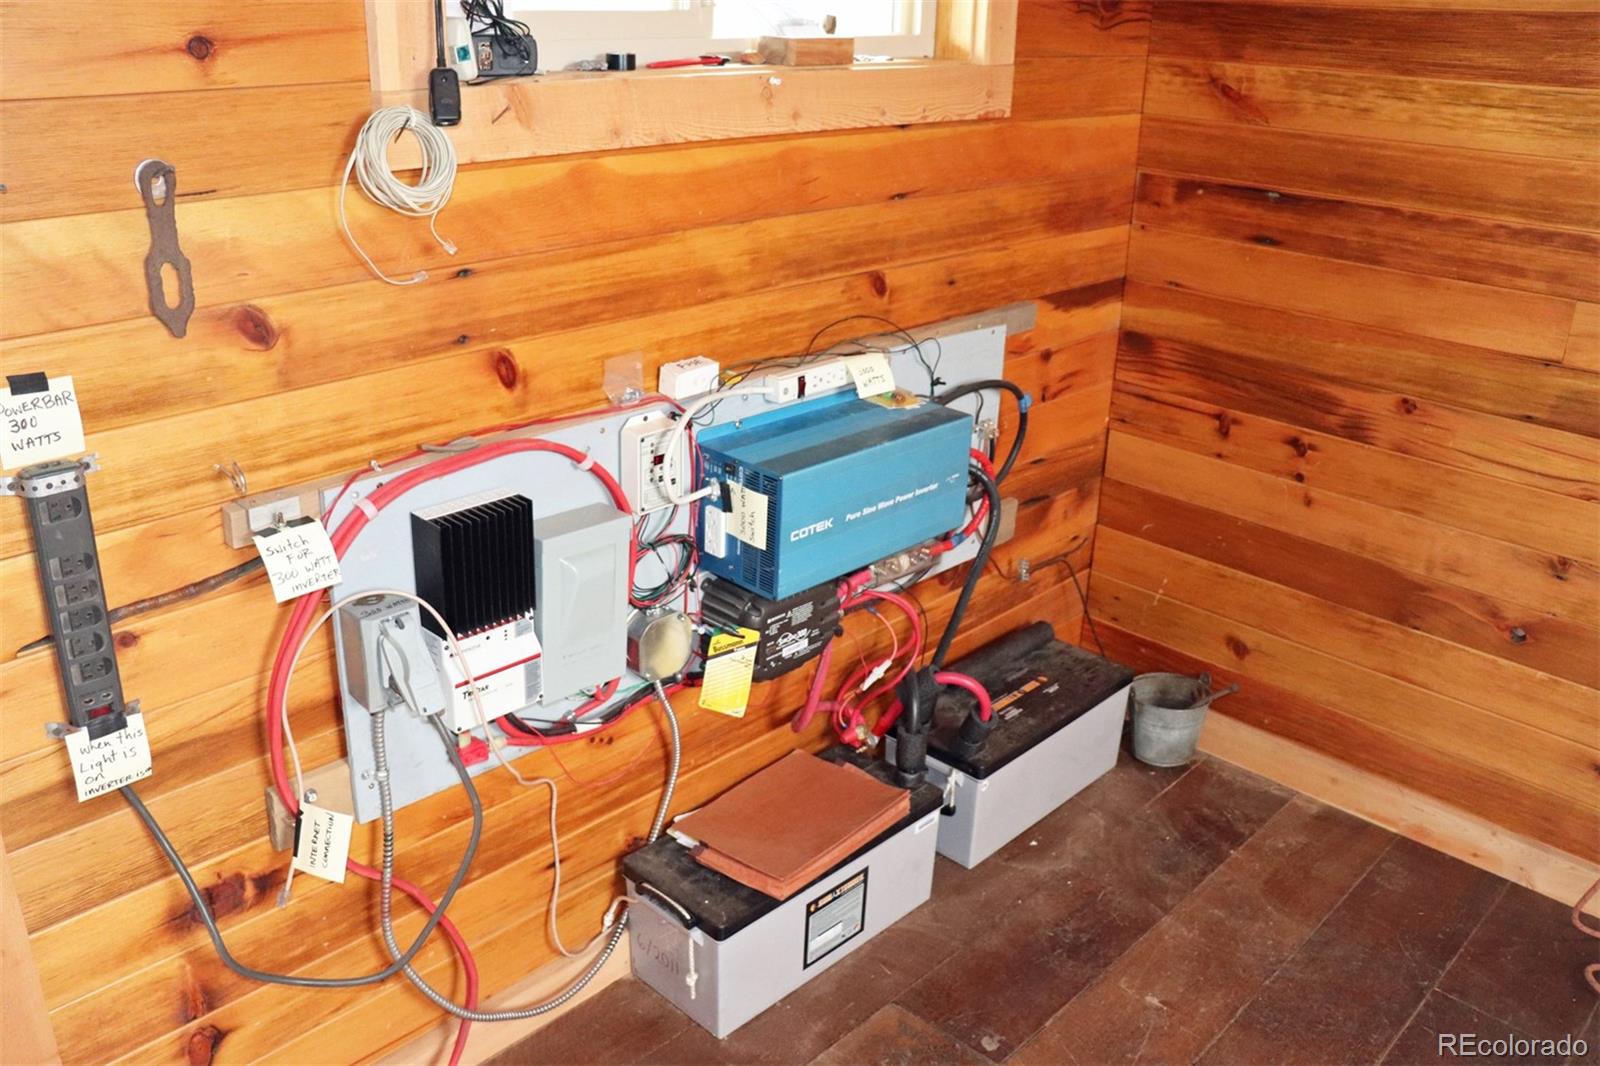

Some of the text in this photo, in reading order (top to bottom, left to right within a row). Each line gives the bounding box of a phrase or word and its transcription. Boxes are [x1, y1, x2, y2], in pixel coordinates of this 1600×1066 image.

[9, 416, 38, 433] 300
[11, 431, 62, 451] WATTS
[790, 517, 834, 542] COTEK
[845, 511, 861, 522] Pure
[266, 534, 310, 557] Switch
[286, 548, 313, 564] FOR
[273, 555, 331, 585] 300 WATT
[116, 728, 144, 744] this
[310, 819, 321, 868] INTERNET
